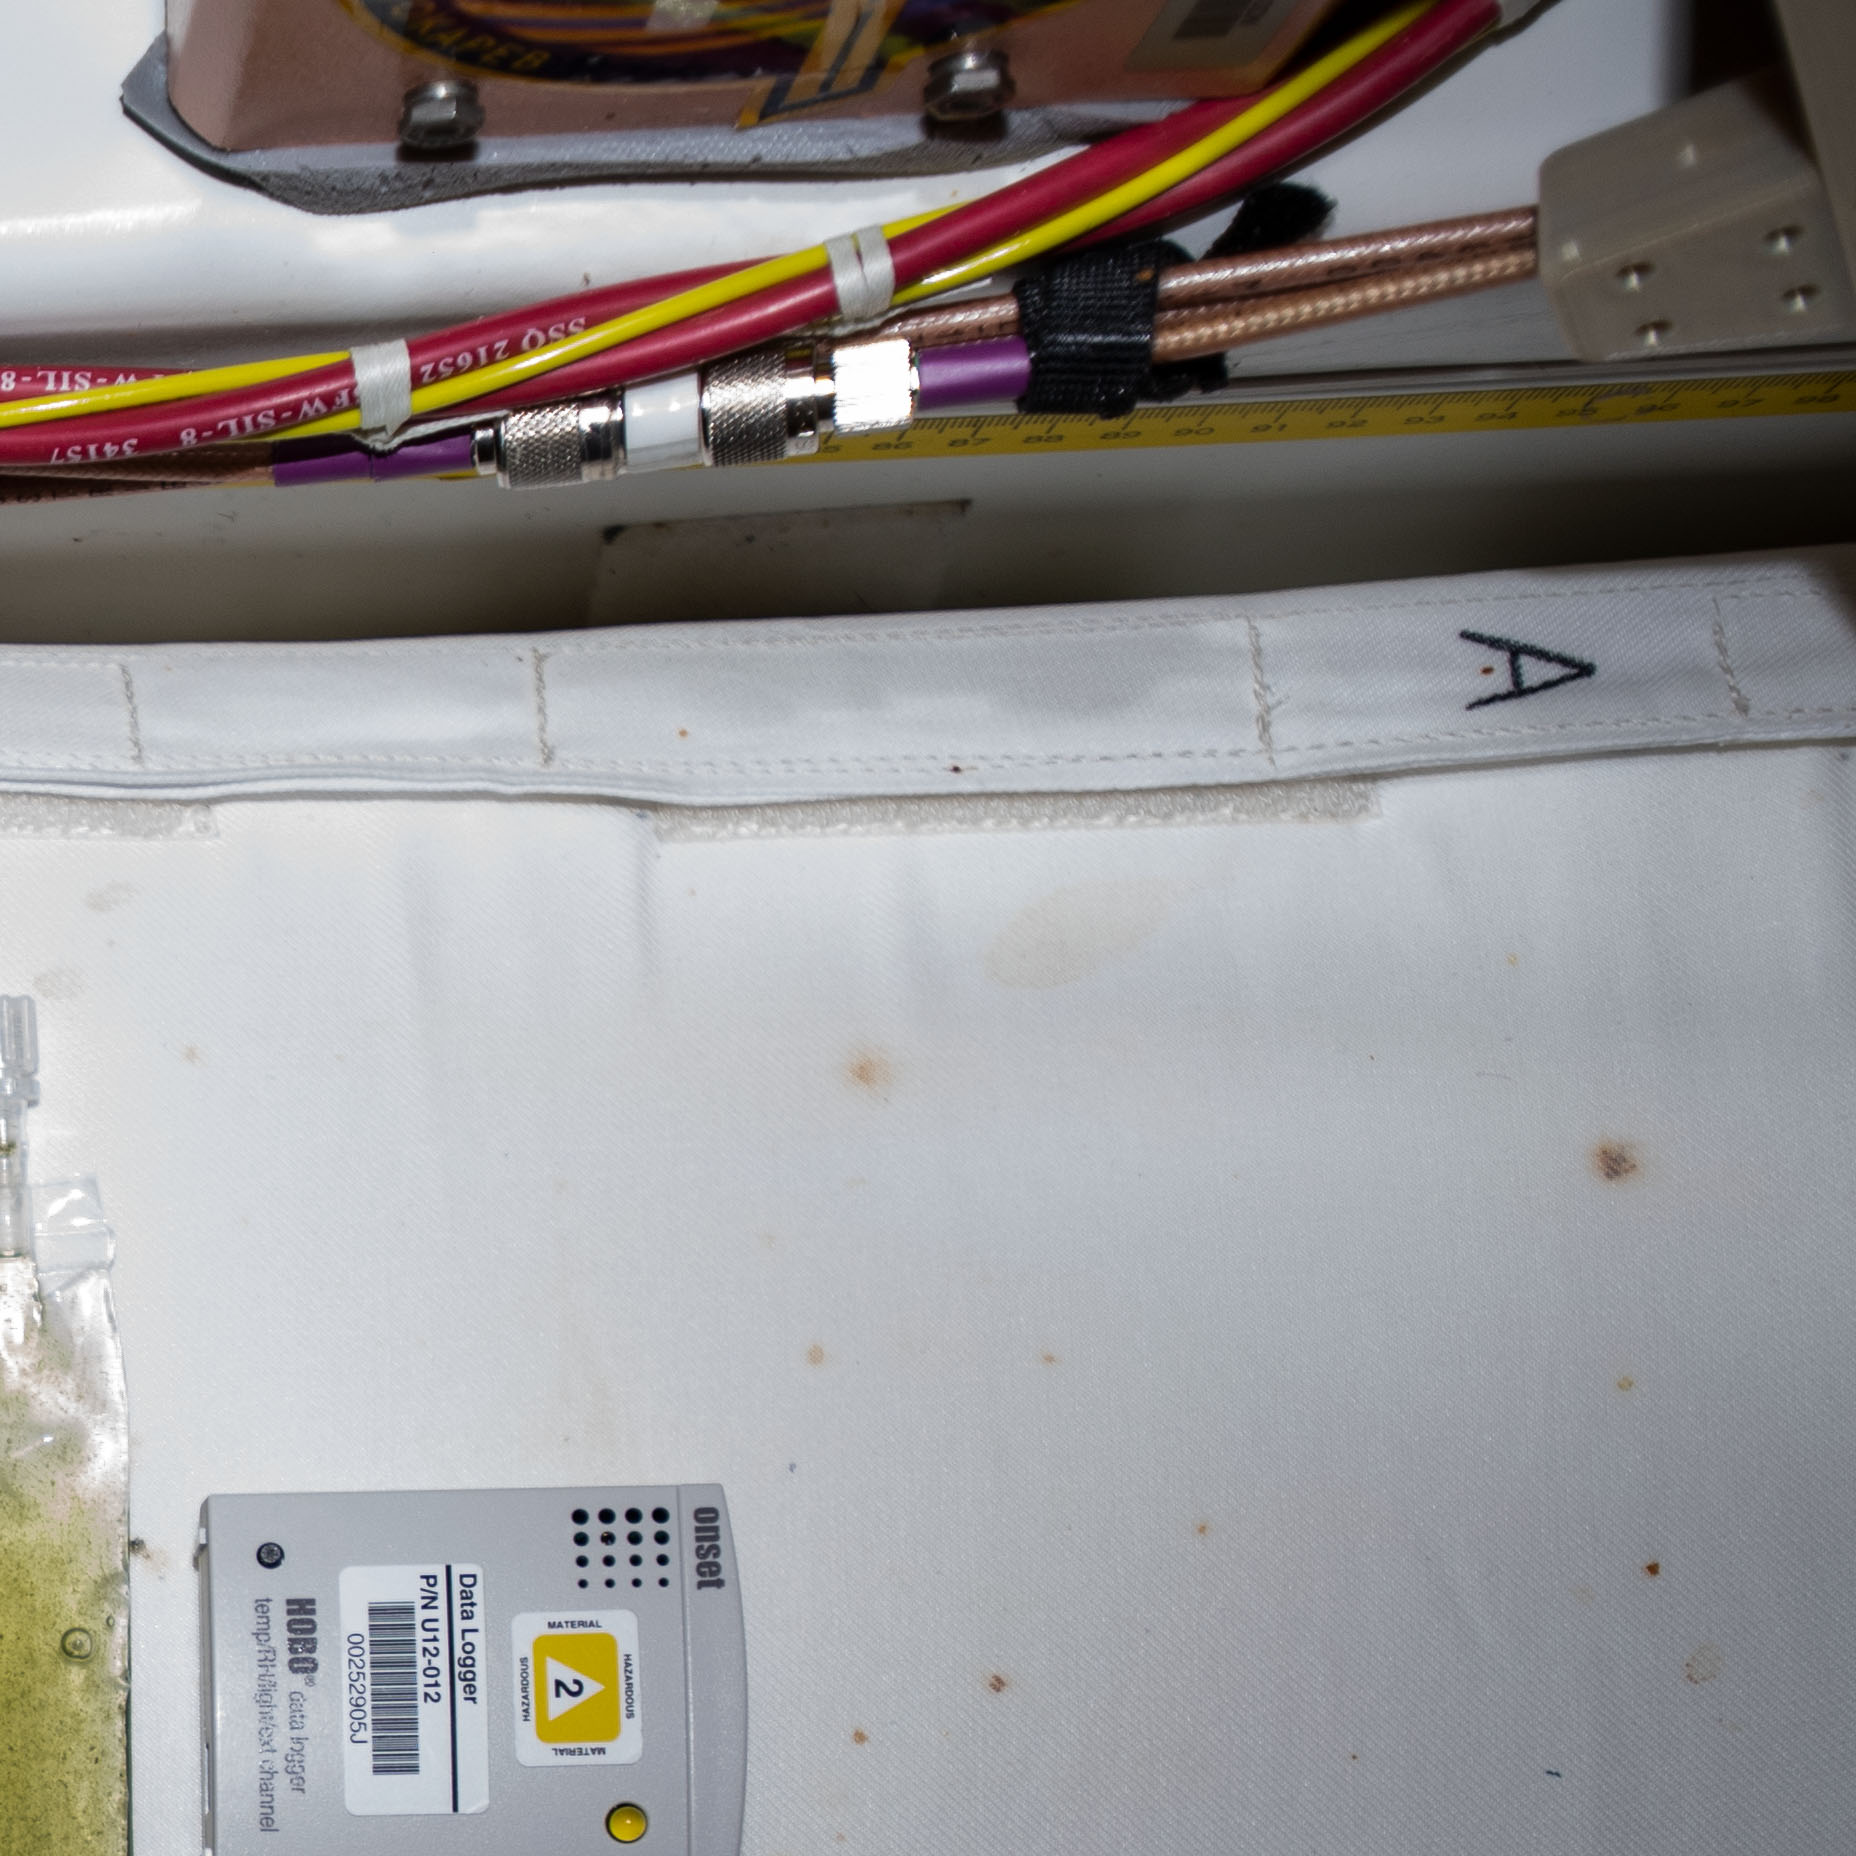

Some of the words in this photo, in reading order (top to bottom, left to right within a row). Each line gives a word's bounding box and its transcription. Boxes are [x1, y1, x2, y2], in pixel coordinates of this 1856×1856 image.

[521, 316, 588, 354] SSQ
[419, 340, 510, 384] 21652
[948, 436, 989, 448] 87
[1099, 429, 1142, 441] 89
[1174, 425, 1216, 437] 90
[1250, 422, 1288, 434] 91
[1325, 417, 1368, 429] 92
[1404, 414, 1446, 426] 93
[1474, 410, 1518, 423] 94
[1555, 405, 1598, 418] 95
[50, 437, 139, 466] 34157
[1459, 629, 1597, 711] A
[693, 1506, 726, 1590] onset
[420, 1575, 438, 1610] P/N
[459, 1574, 478, 1620] Data
[548, 1620, 603, 1629] MATERIAL
[421, 1618, 441, 1703] U12-012
[457, 1628, 479, 1704] Logger
[347, 1633, 368, 1744] 00252905J
[519, 1657, 531, 1721] HAZARDOUS
[554, 1678, 584, 1698] 2
[623, 1653, 635, 1719] HAZARDOUS
[287, 1691, 306, 1730] data
[552, 1747, 606, 1756] MATERIAL
[258, 1758, 280, 1833] channel
